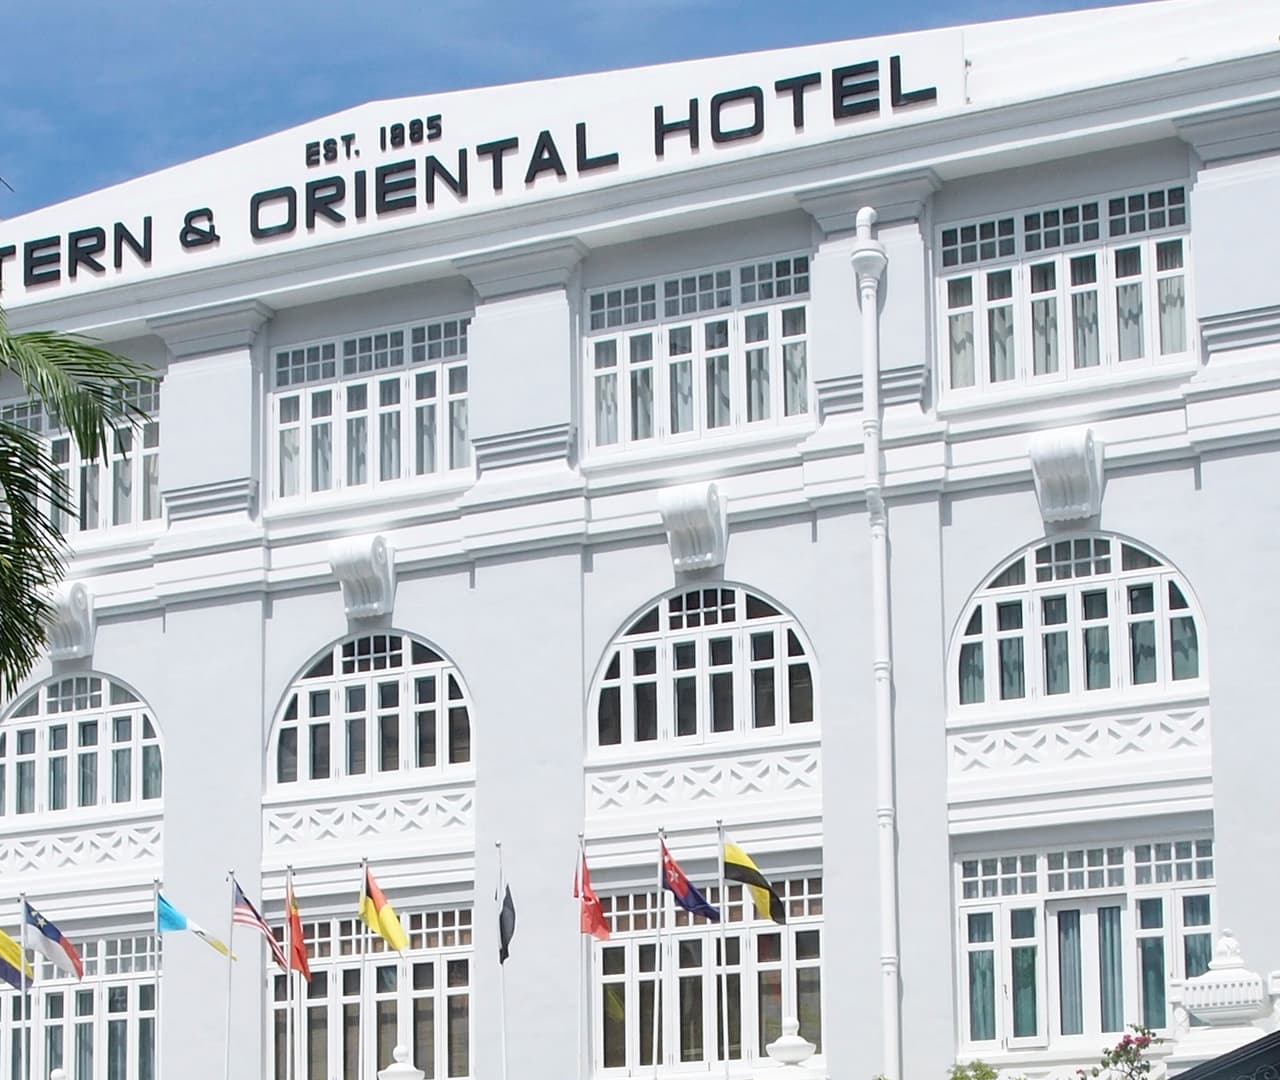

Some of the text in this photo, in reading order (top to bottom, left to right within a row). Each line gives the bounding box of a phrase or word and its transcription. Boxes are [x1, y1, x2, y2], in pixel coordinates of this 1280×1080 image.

[179, 207, 221, 249] &
[250, 122, 619, 240] ORIENTAL
[654, 55, 937, 157] HOTEL
[305, 114, 443, 168] EST. 1885
